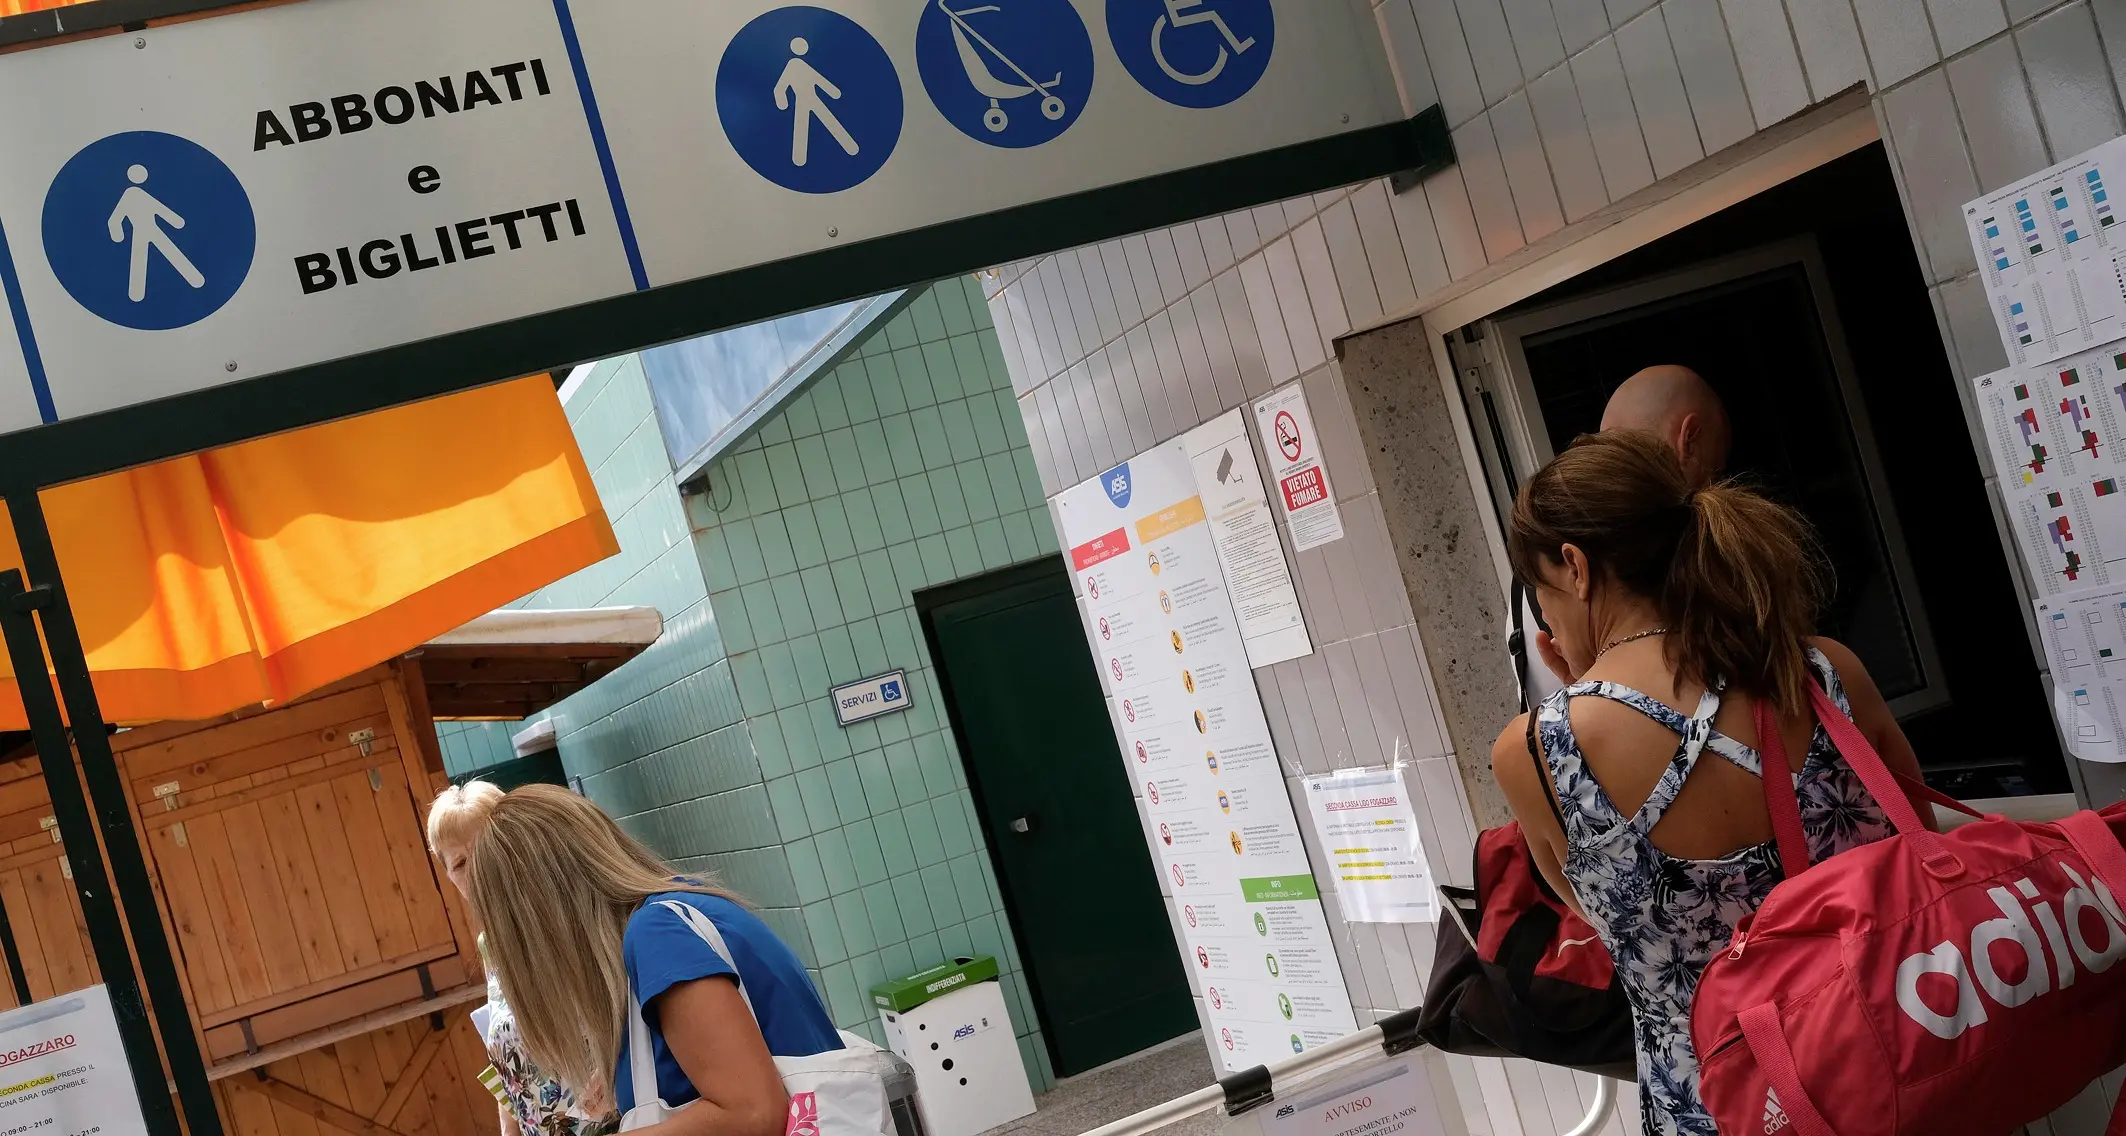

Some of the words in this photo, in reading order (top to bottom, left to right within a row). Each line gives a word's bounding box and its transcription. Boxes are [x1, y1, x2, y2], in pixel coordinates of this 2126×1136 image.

[252, 58, 551, 151] ABBONATI
[407, 165, 441, 194] e
[294, 199, 586, 294] BIGLIETTI
[1286, 470, 1317, 492] VIETATO
[1291, 486, 1322, 507] FUMARE
[841, 692, 877, 709] SERVIZI
[1896, 861, 2126, 1040] adid
[926, 972, 967, 994] INDIFFERENZIATA
[30, 1075, 56, 1087] CASSA
[56, 1066, 87, 1080] PRESSO
[18, 1091, 40, 1103] SARA'
[41, 1077, 88, 1097] DISPONIBILE:
[1325, 1096, 1372, 1122] AVVISO
[1392, 1113, 1399, 1121] A
[1399, 1106, 1417, 1117] NON
[8, 1125, 28, 1136] 09:00
[34, 1118, 53, 1129] 21:00
